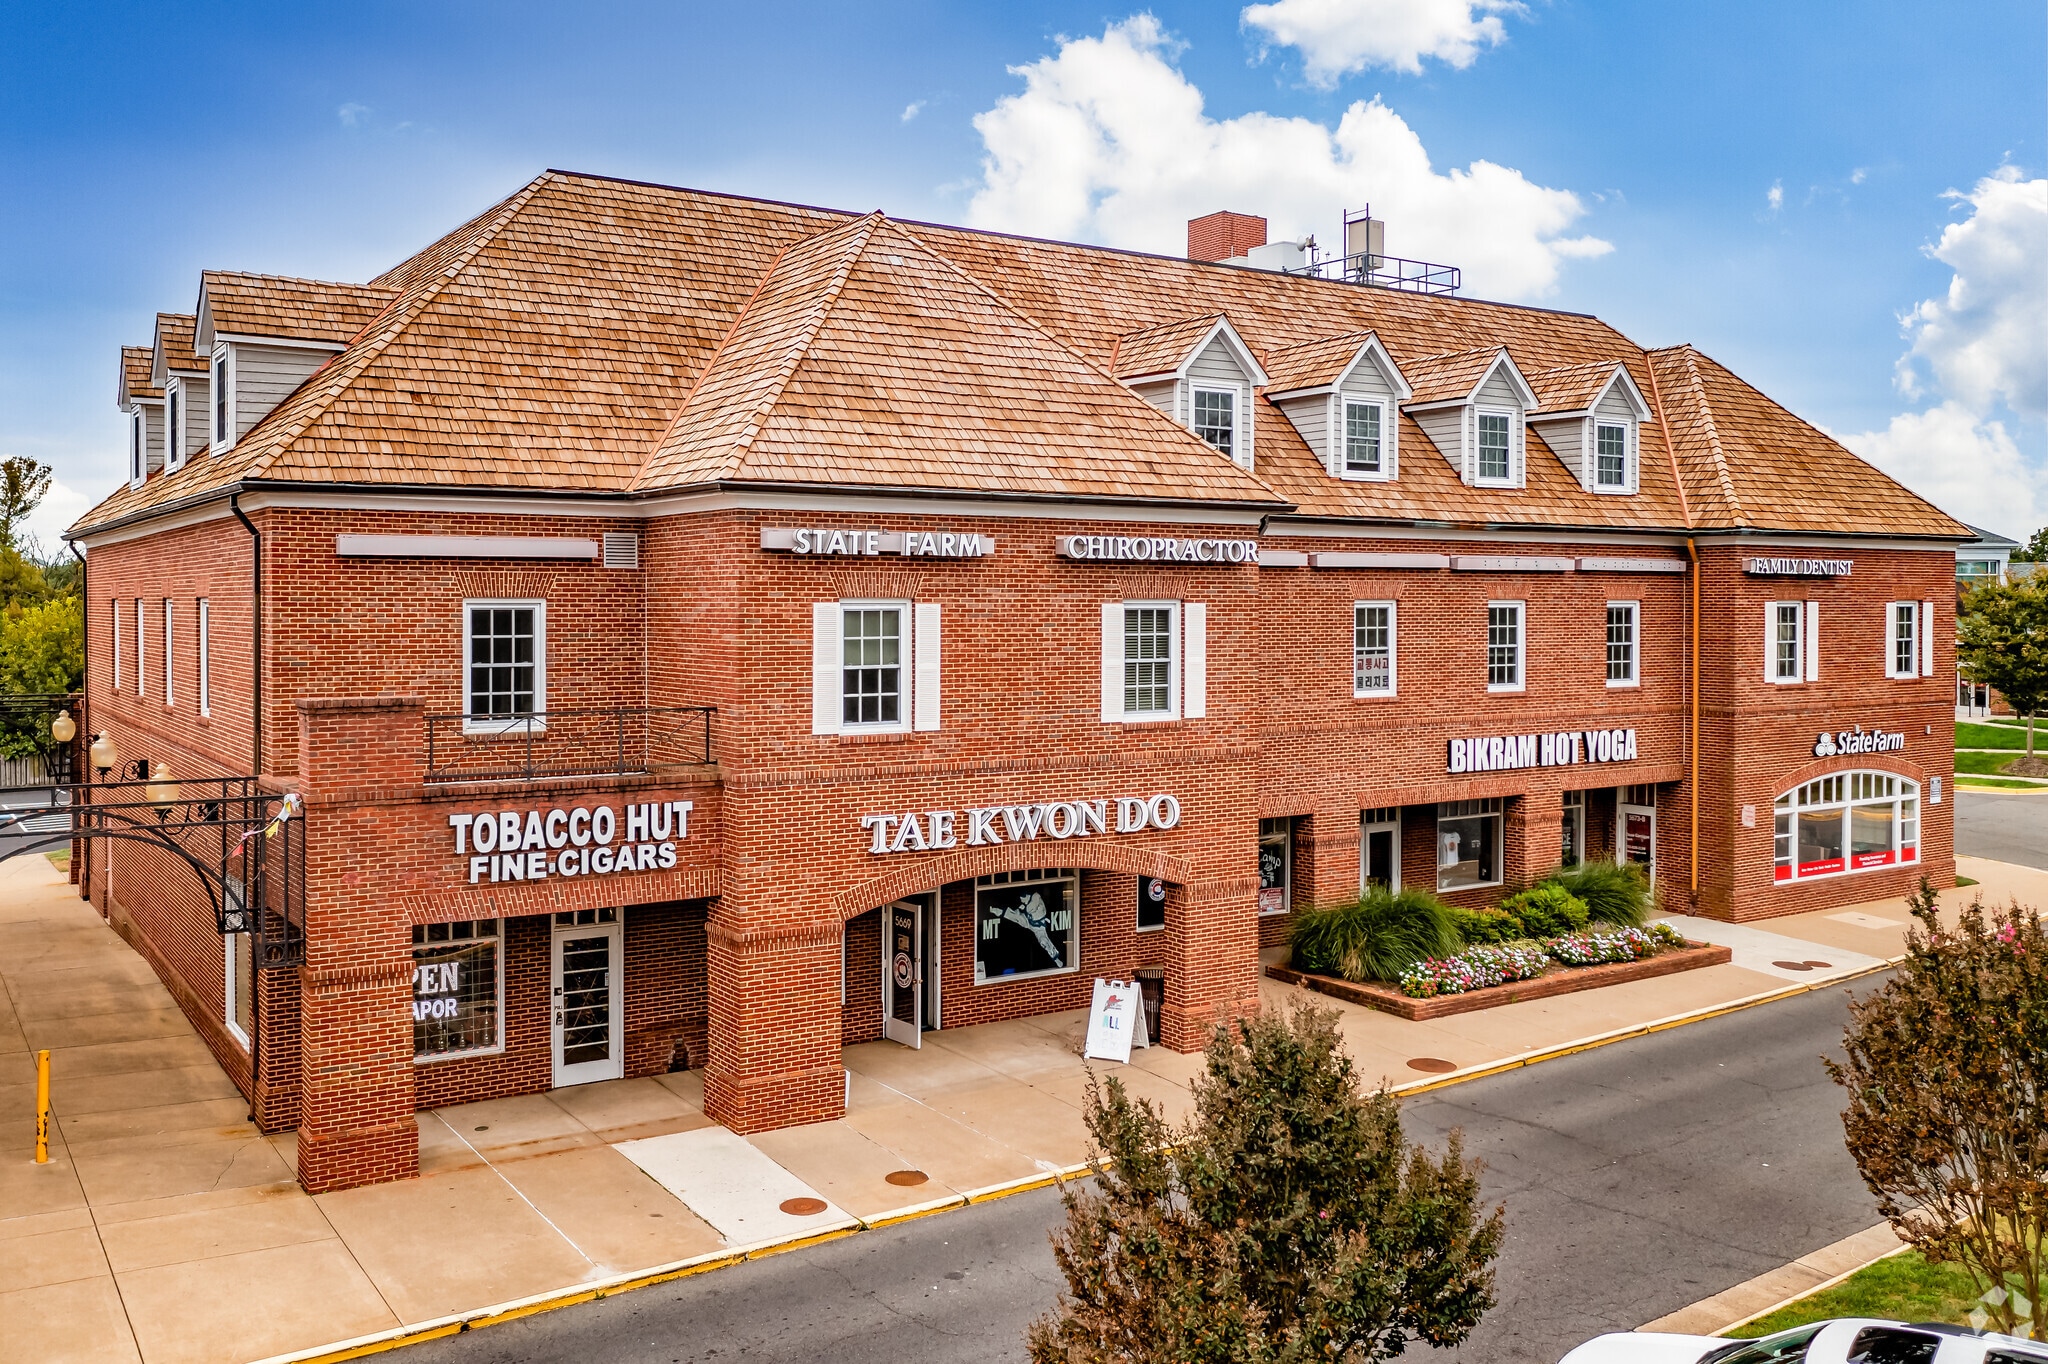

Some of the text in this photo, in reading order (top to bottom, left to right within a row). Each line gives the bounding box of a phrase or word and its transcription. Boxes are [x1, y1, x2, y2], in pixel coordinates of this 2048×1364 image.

[793, 528, 982, 557] STATE FARM
[1068, 535, 1260, 562] CHIROPRACTOR
[1754, 558, 1854, 576] FAMILY DENTIST
[1449, 729, 1638, 773] BIKRAM HOT YOGA
[449, 801, 693, 855] TOBACCO HUT
[861, 794, 1181, 854] TAE KWON DO
[469, 842, 678, 884] FINE CIGARS
[895, 915, 912, 930] 5669
[982, 918, 1001, 940] MT
[1050, 910, 1072, 932] KIM
[412, 961, 460, 995] EN
